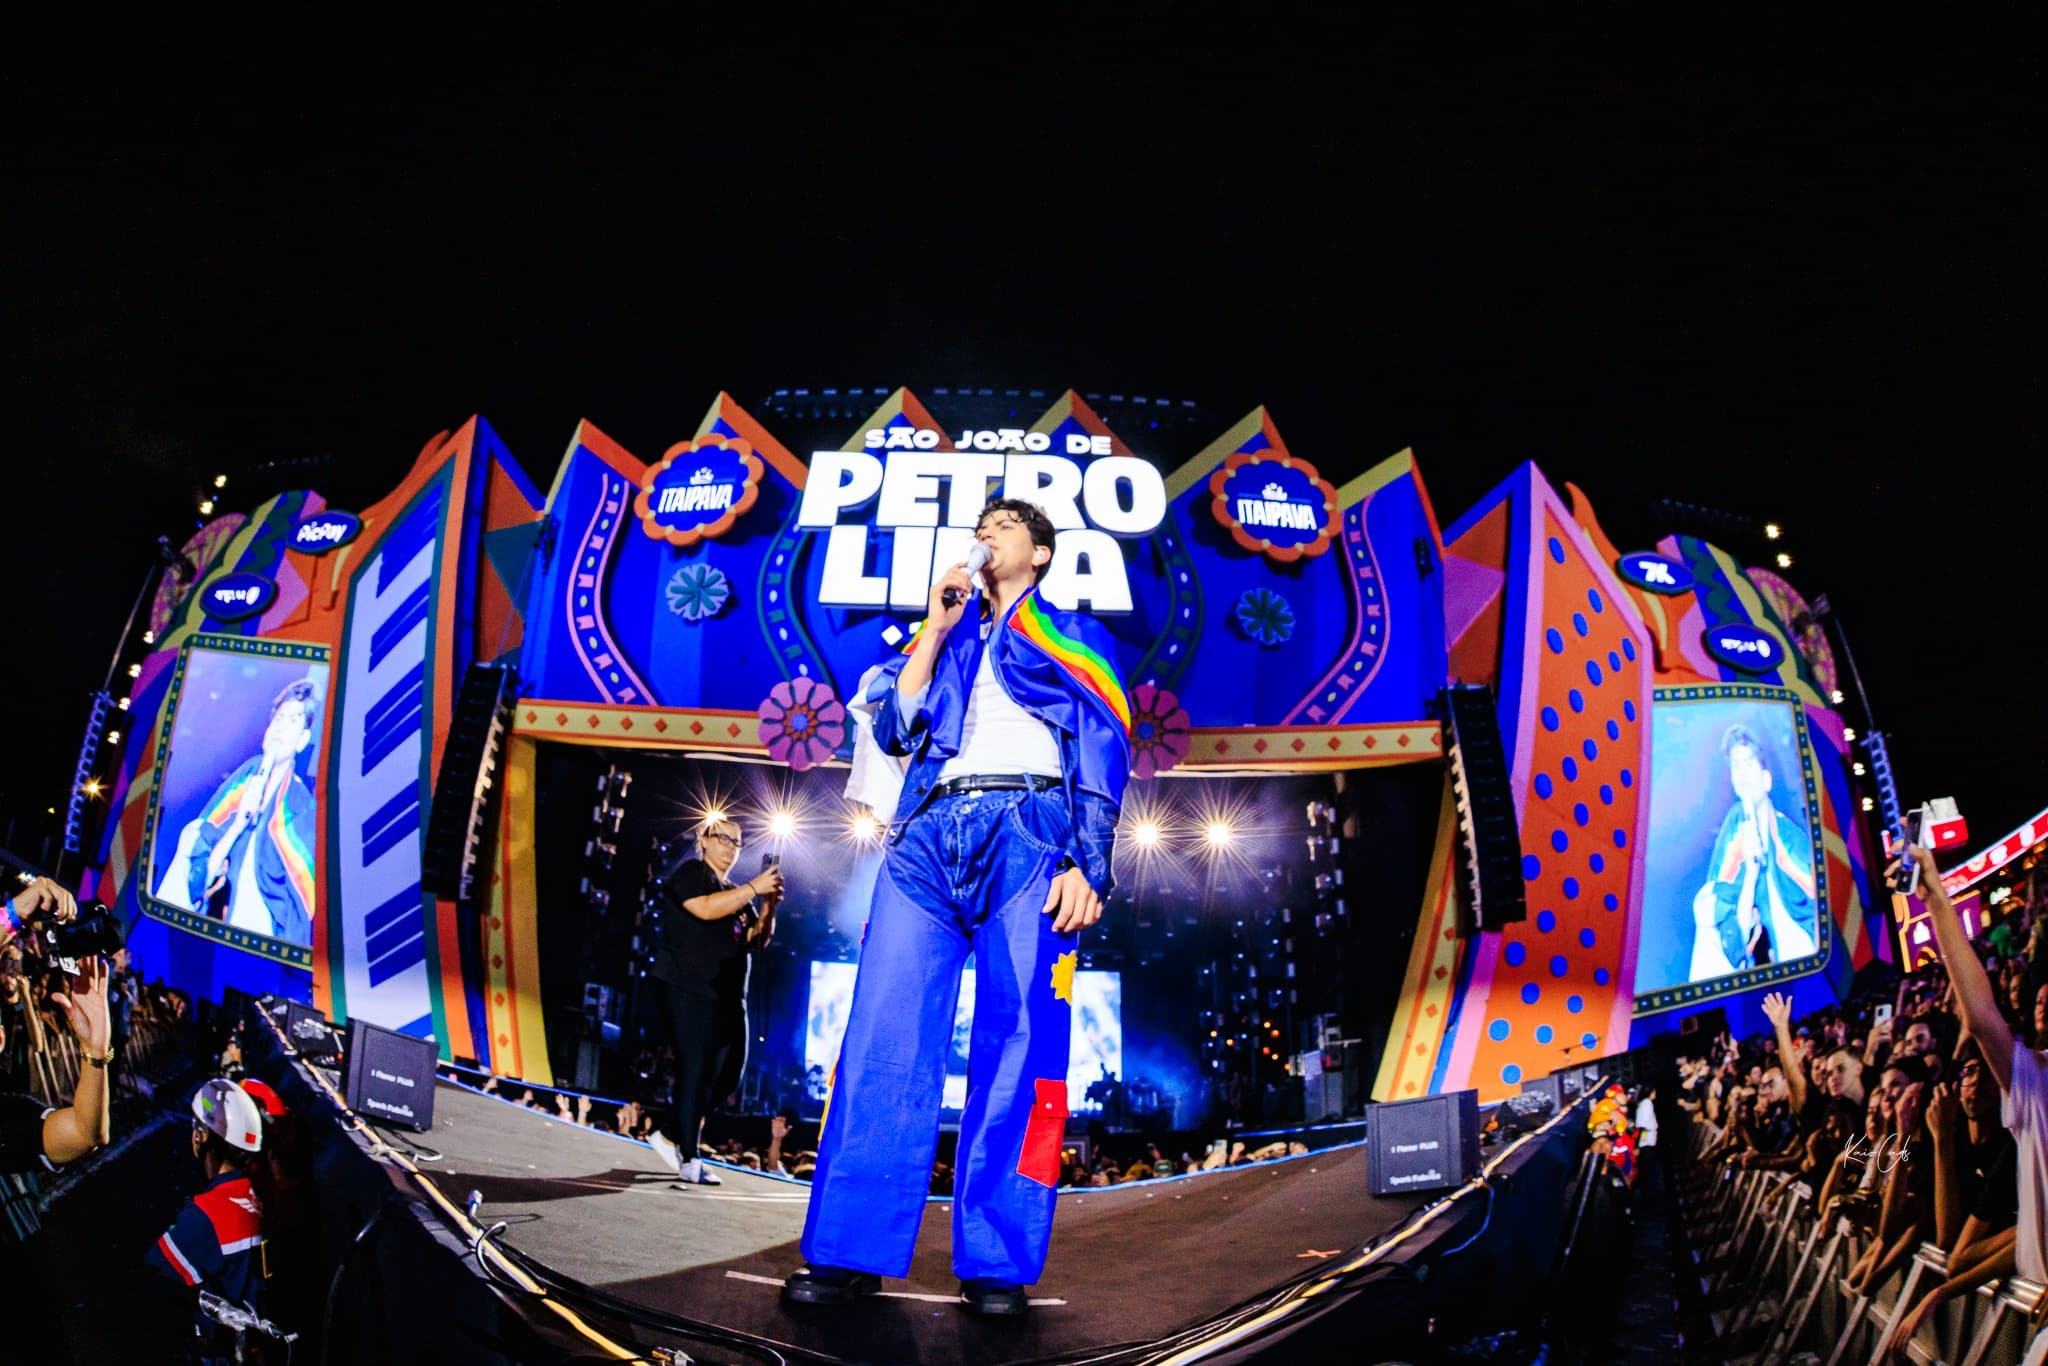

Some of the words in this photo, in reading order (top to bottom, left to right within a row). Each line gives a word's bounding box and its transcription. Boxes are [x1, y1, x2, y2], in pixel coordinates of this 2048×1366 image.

[864, 427, 940, 449] SÃO
[954, 428, 1051, 453] JOÃO
[1066, 434, 1112, 455] DE
[658, 484, 733, 513] ITAIPAVA
[799, 450, 1167, 534] PETRO
[1237, 499, 1317, 530] ITAIPAVA
